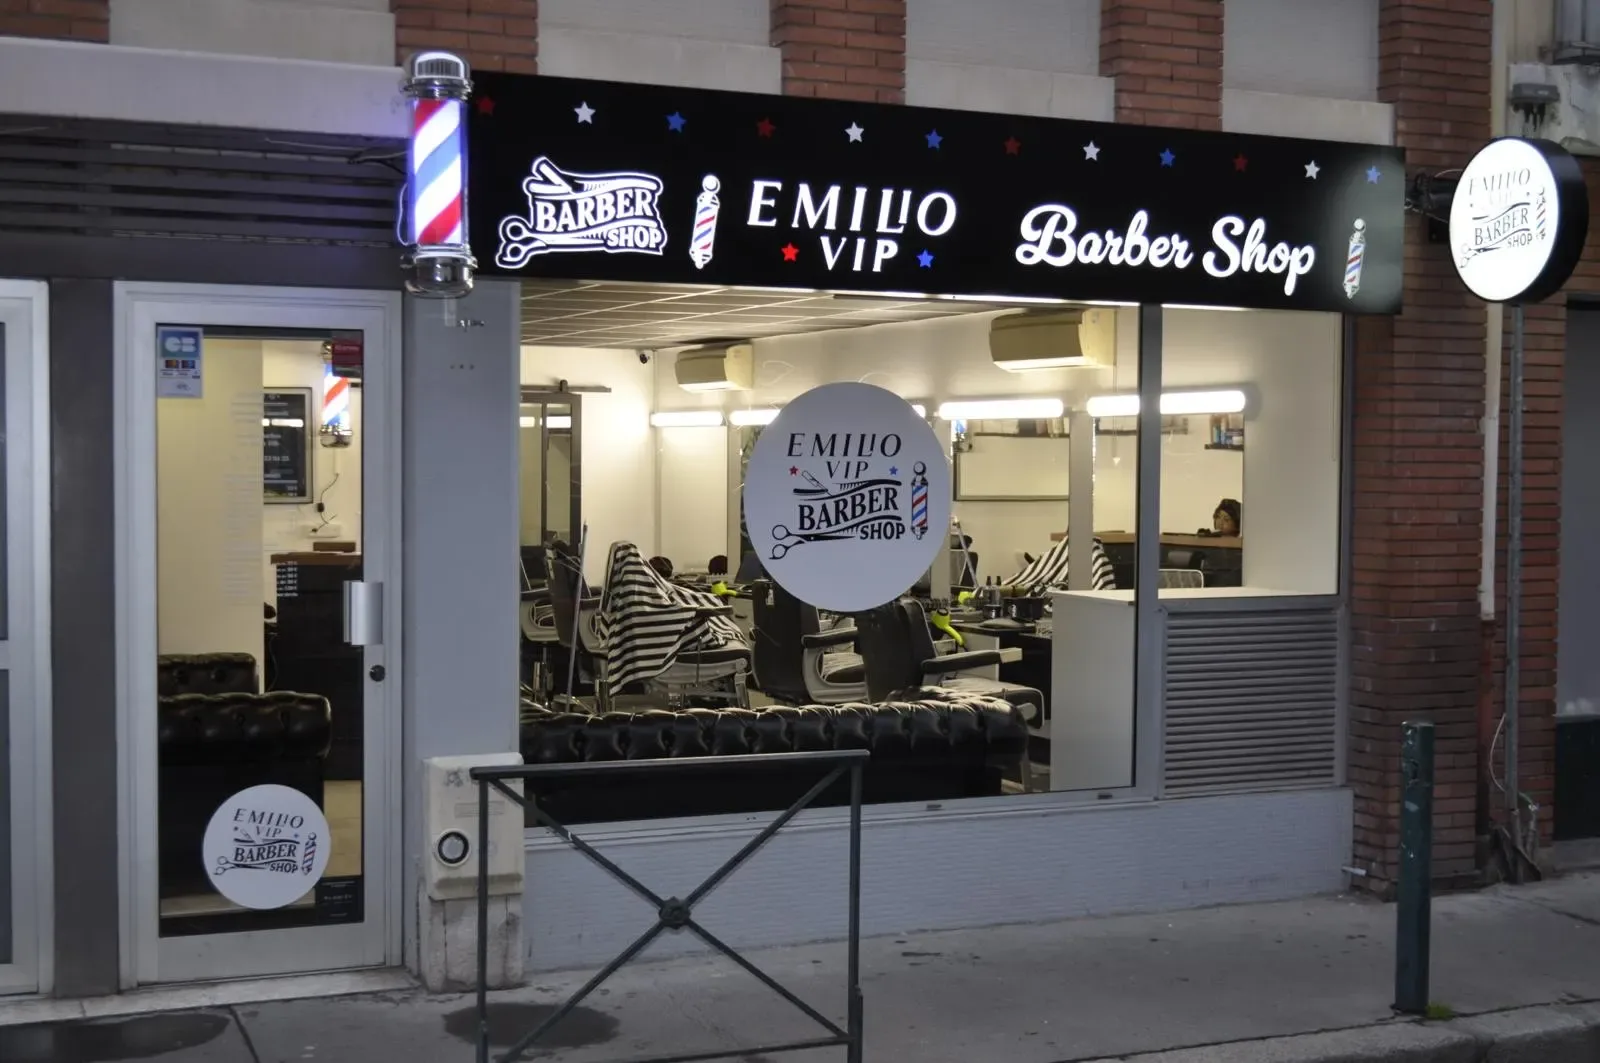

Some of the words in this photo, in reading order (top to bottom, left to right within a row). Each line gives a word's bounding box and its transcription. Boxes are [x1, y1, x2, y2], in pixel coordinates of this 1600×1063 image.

[535, 188, 654, 233] BARBER
[747, 180, 957, 236] EMILIO
[607, 226, 662, 249] SHOP
[1474, 207, 1529, 246] BARBER
[1015, 204, 1194, 269] Barber
[1202, 216, 1315, 296] Shop
[1507, 232, 1533, 248] SHOP
[820, 236, 899, 272] VIP
[787, 433, 902, 457] EMILIO
[826, 460, 869, 479] VIP
[798, 487, 899, 531] BARBER
[859, 521, 906, 541] SHOP
[233, 808, 304, 829] EMILIO
[255, 825, 282, 838] VIP
[233, 843, 297, 863] BARBER
[269, 862, 298, 874] SHOP
